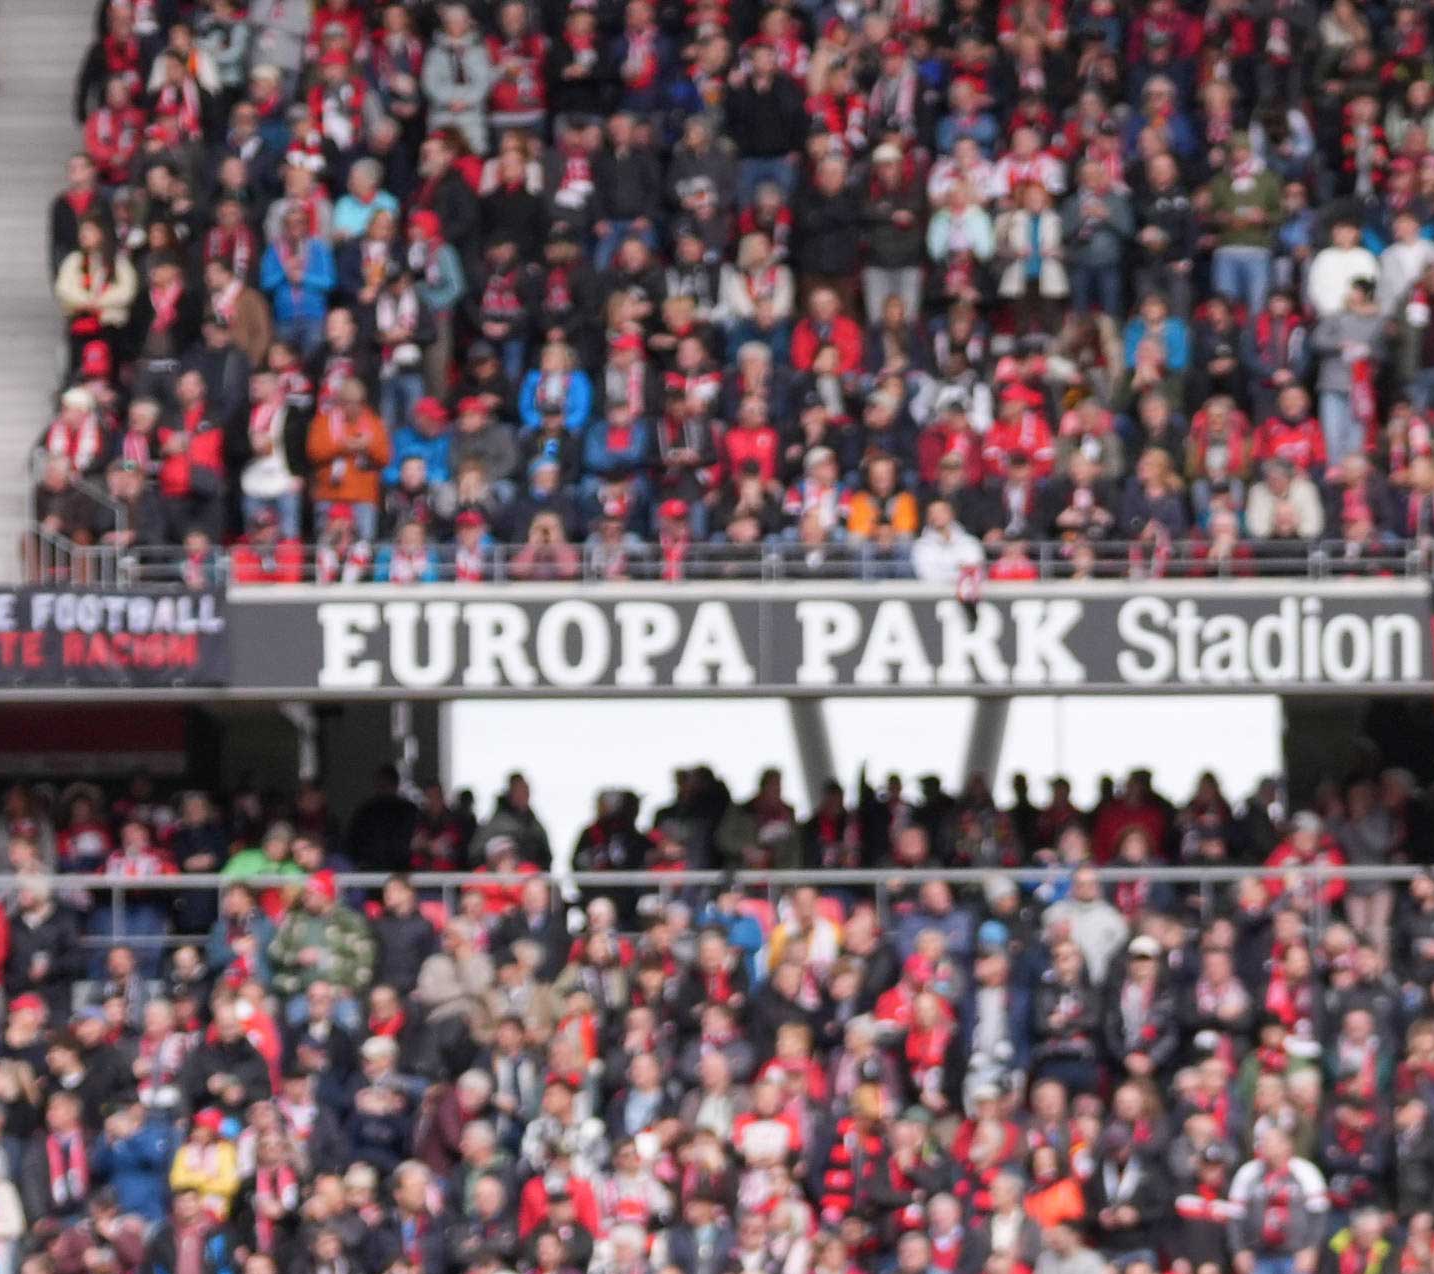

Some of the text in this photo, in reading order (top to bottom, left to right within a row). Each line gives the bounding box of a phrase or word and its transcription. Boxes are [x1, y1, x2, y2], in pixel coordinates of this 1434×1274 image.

[30, 593, 226, 634] FOOTBALL
[317, 595, 1422, 688] EUROPA PARK Stadion
